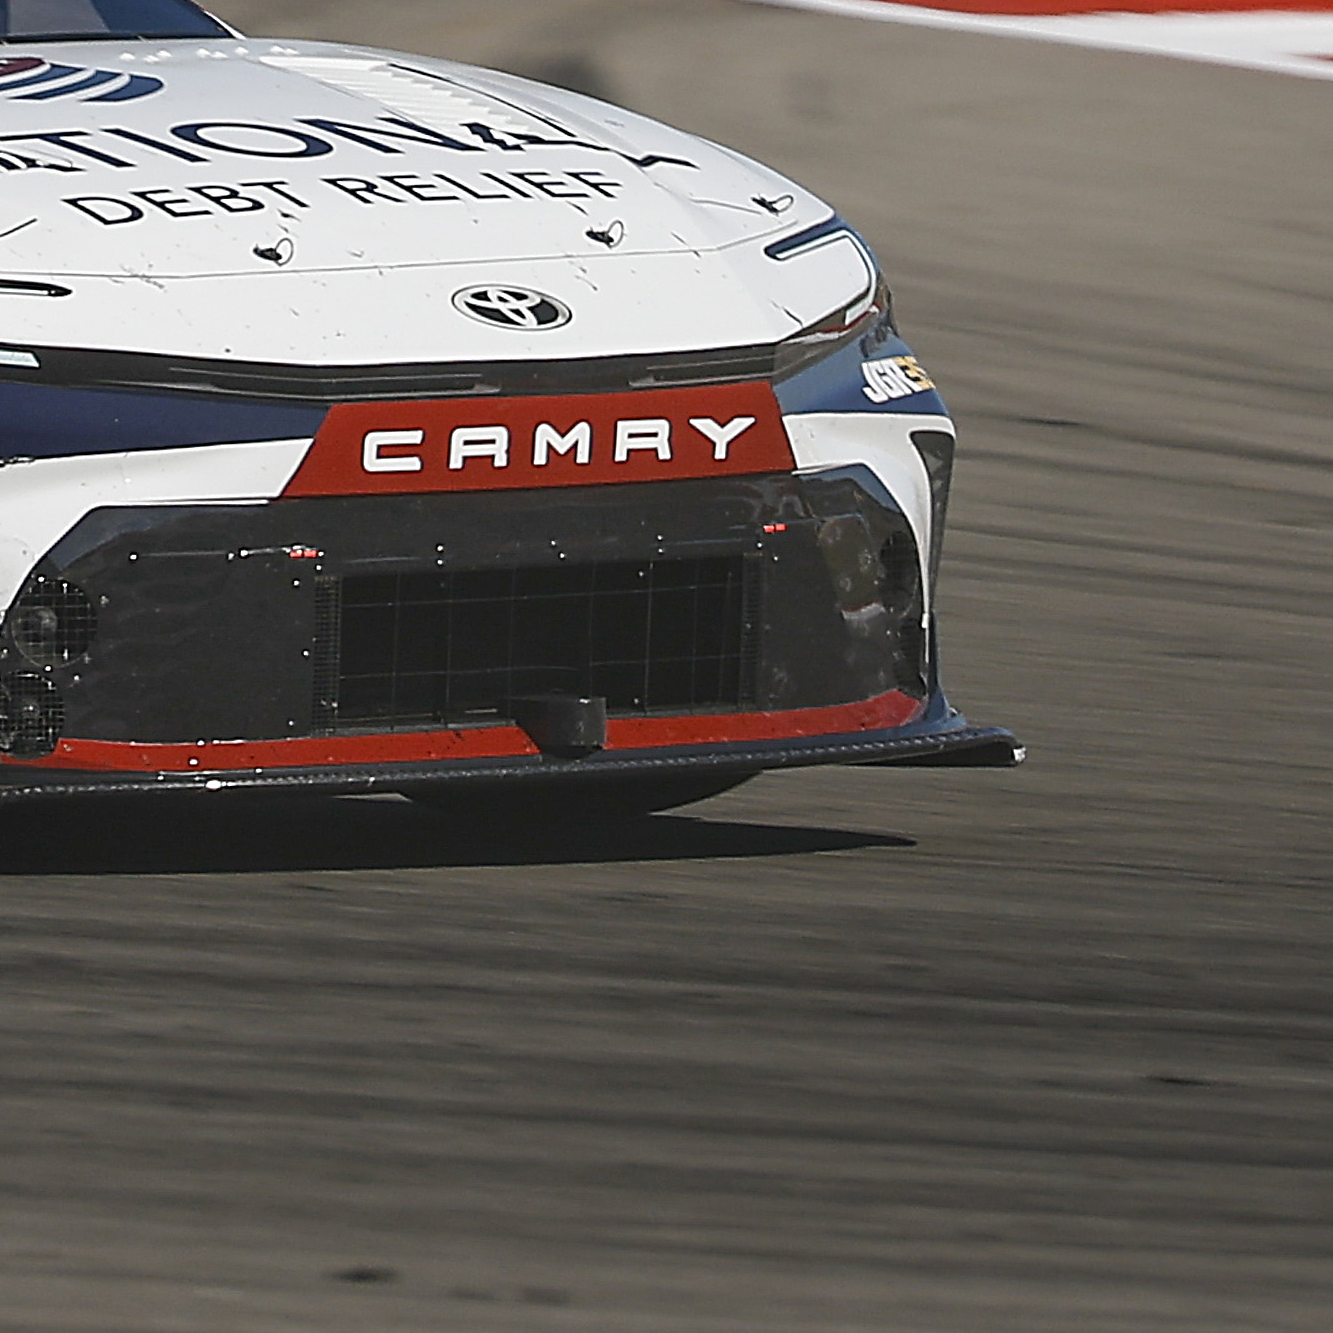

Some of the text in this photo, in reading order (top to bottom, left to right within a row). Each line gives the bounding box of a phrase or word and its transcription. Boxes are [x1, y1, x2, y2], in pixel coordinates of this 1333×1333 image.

[63, 169, 624, 225] DEBT RELIEF
[362, 415, 756, 472] CAMRY
